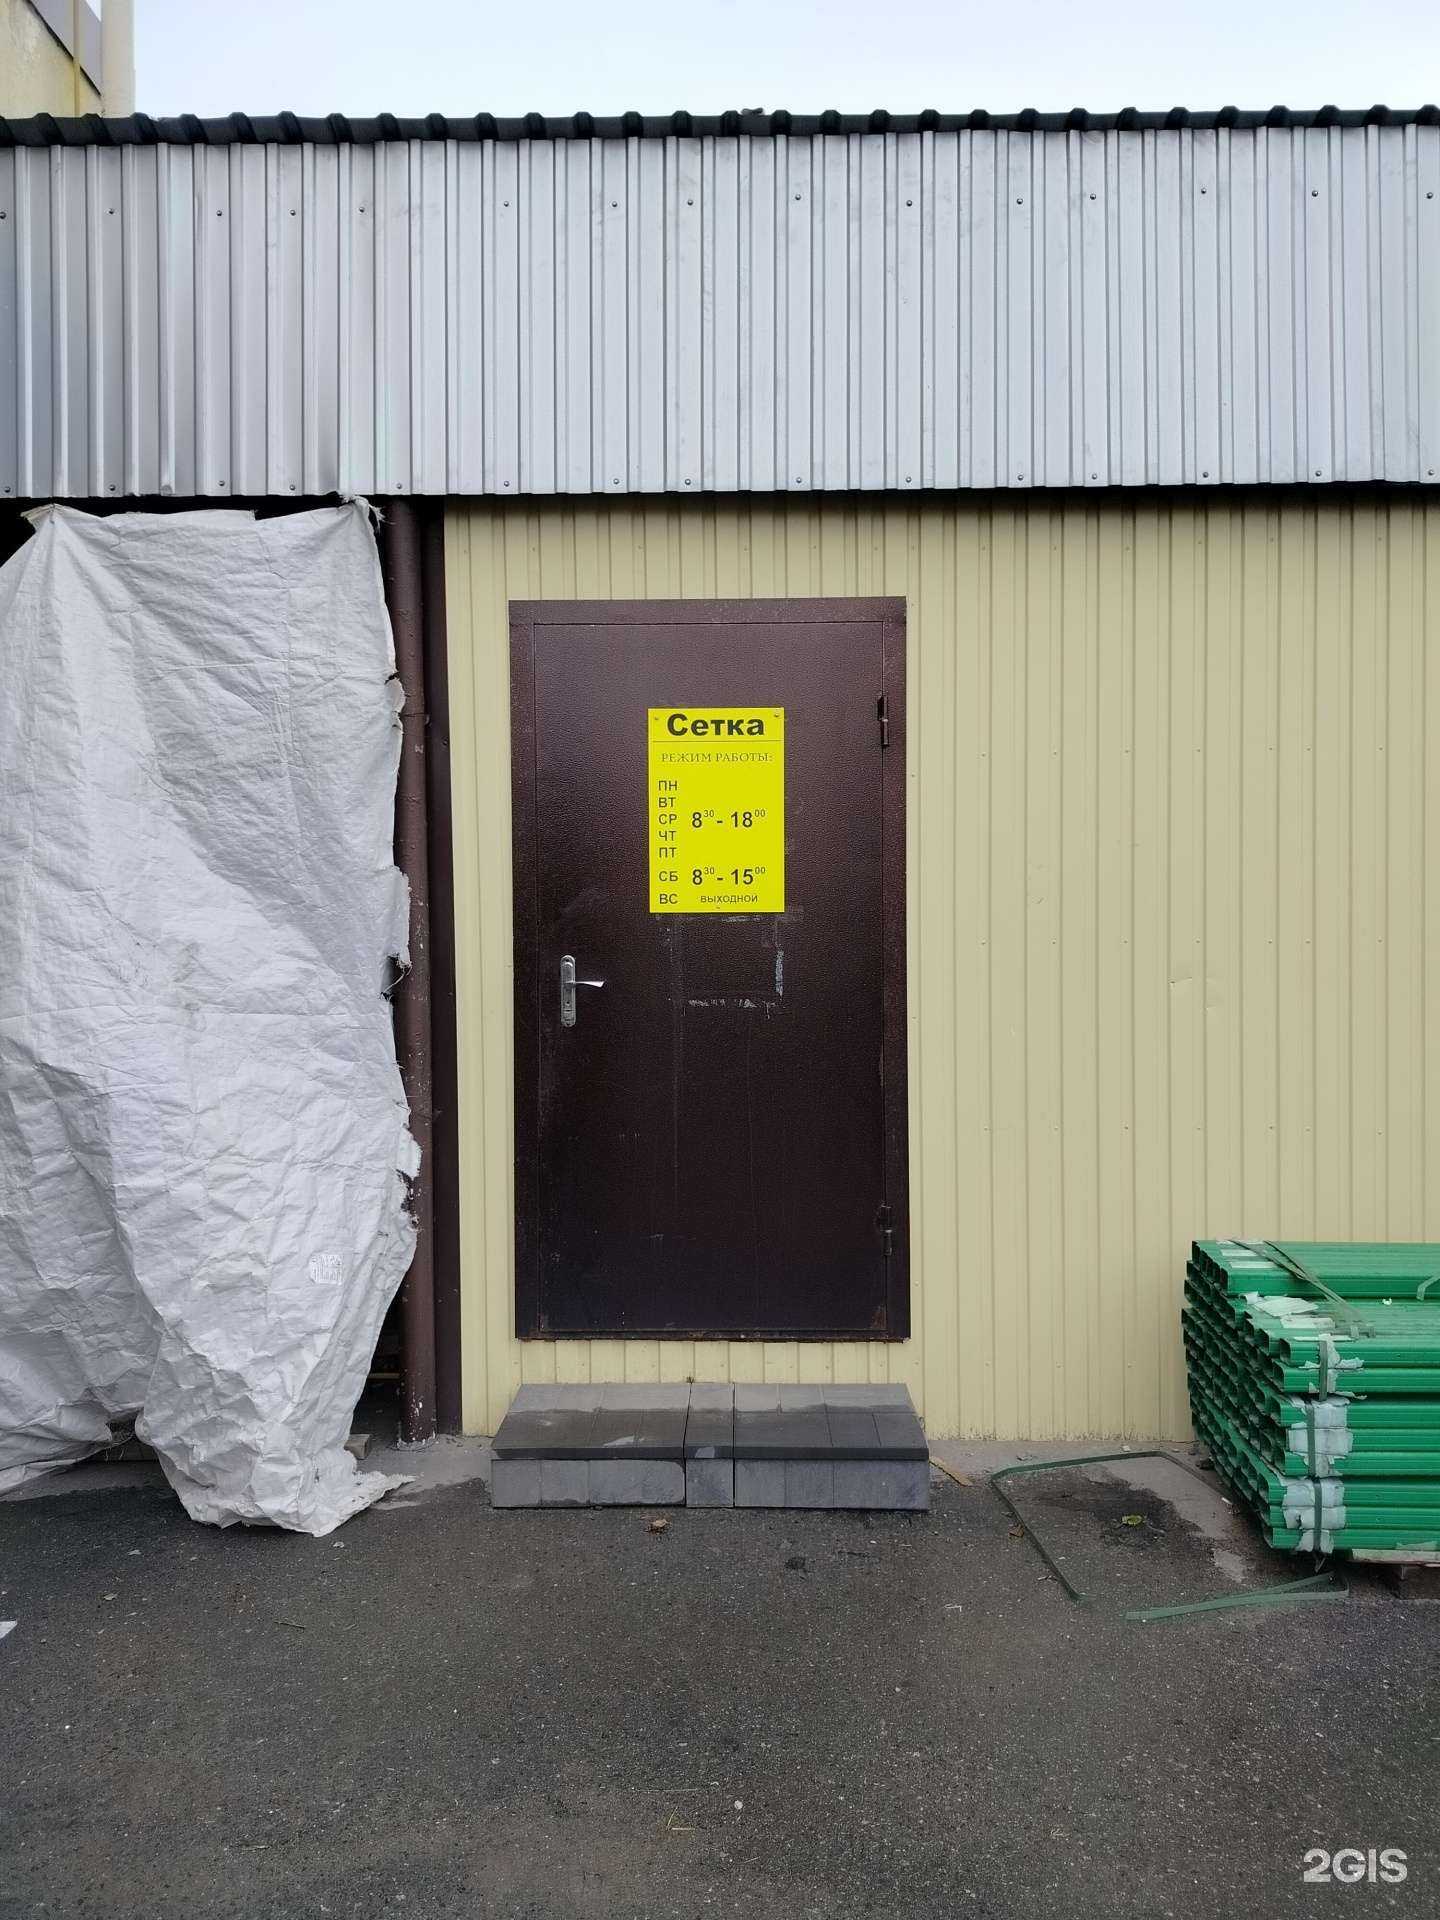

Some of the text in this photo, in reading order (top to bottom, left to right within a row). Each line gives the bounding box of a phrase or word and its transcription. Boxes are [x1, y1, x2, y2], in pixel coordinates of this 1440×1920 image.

[667, 713, 765, 736] Сетка
[662, 753, 773, 762] РЕЖИМ РАБОТЫ:
[658, 780, 678, 791] ПН
[658, 797, 676, 808] ВТ
[658, 813, 677, 825] СР
[658, 830, 677, 842] ЧТ
[658, 847, 677, 858] ПТ
[658, 870, 678, 882] СБ
[659, 893, 678, 905] ВС
